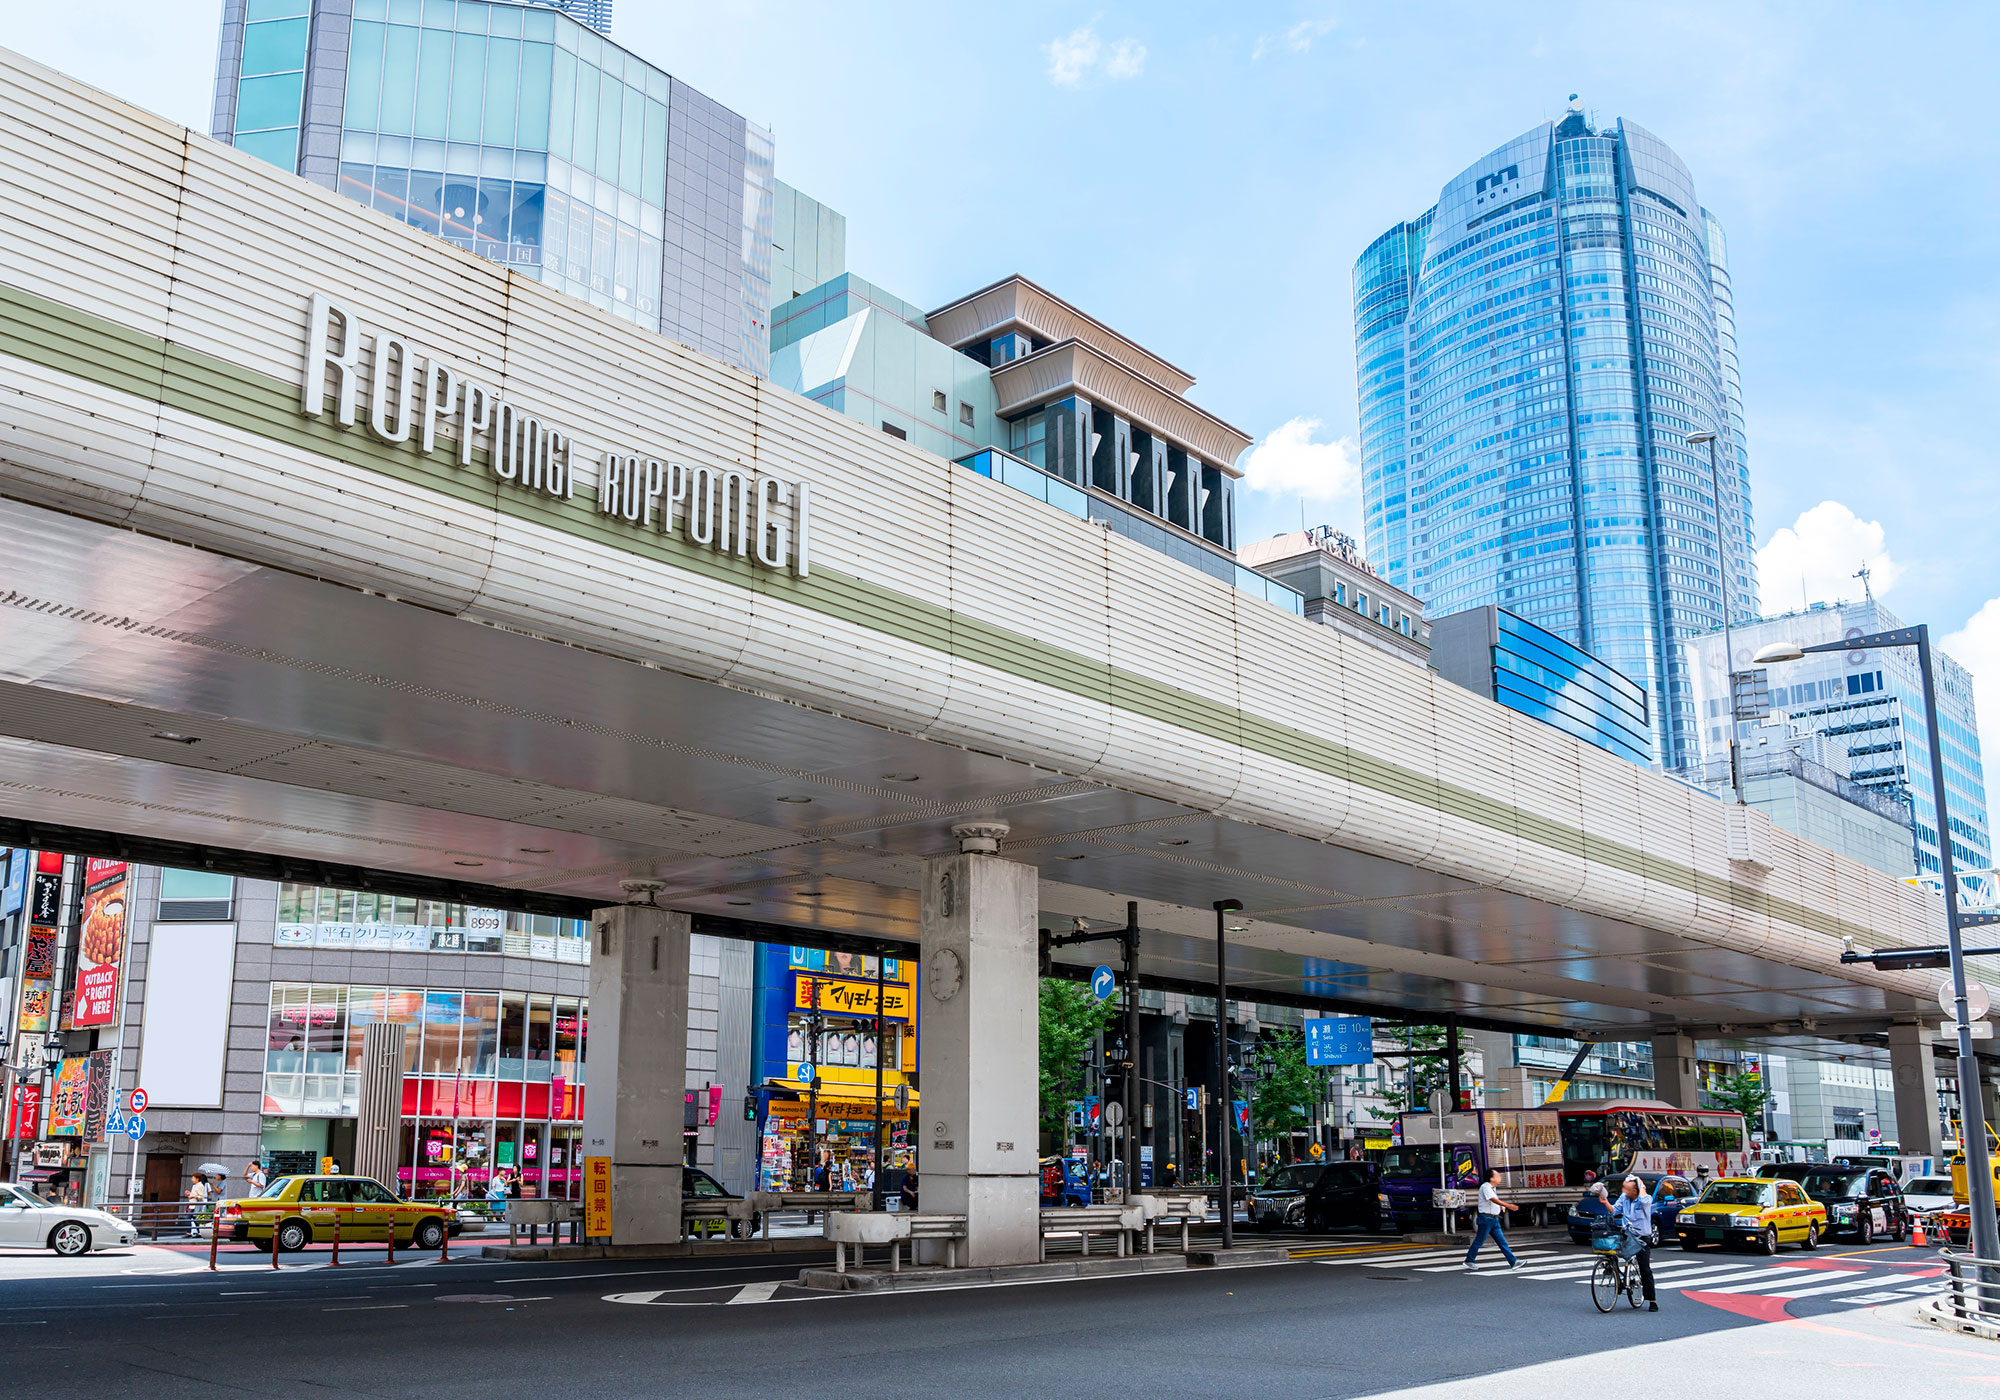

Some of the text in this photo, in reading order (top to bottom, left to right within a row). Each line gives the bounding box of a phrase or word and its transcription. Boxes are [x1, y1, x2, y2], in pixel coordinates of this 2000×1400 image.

[1477, 182, 1520, 205] MORI
[301, 292, 811, 579] ROPPONGI ROPPONGI
[471, 917, 500, 930] 8999
[323, 926, 415, 940] 平石クリニック
[25, 936, 48, 973] やぶ屋
[84, 970, 114, 987] OUTBACK
[91, 985, 113, 1001] RIGHT
[92, 1000, 111, 1016] HERE
[903, 1024, 915, 1038] 薬
[820, 1102, 864, 1117] マツモトキヨシ
[593, 1161, 607, 1232] 転回禁止
